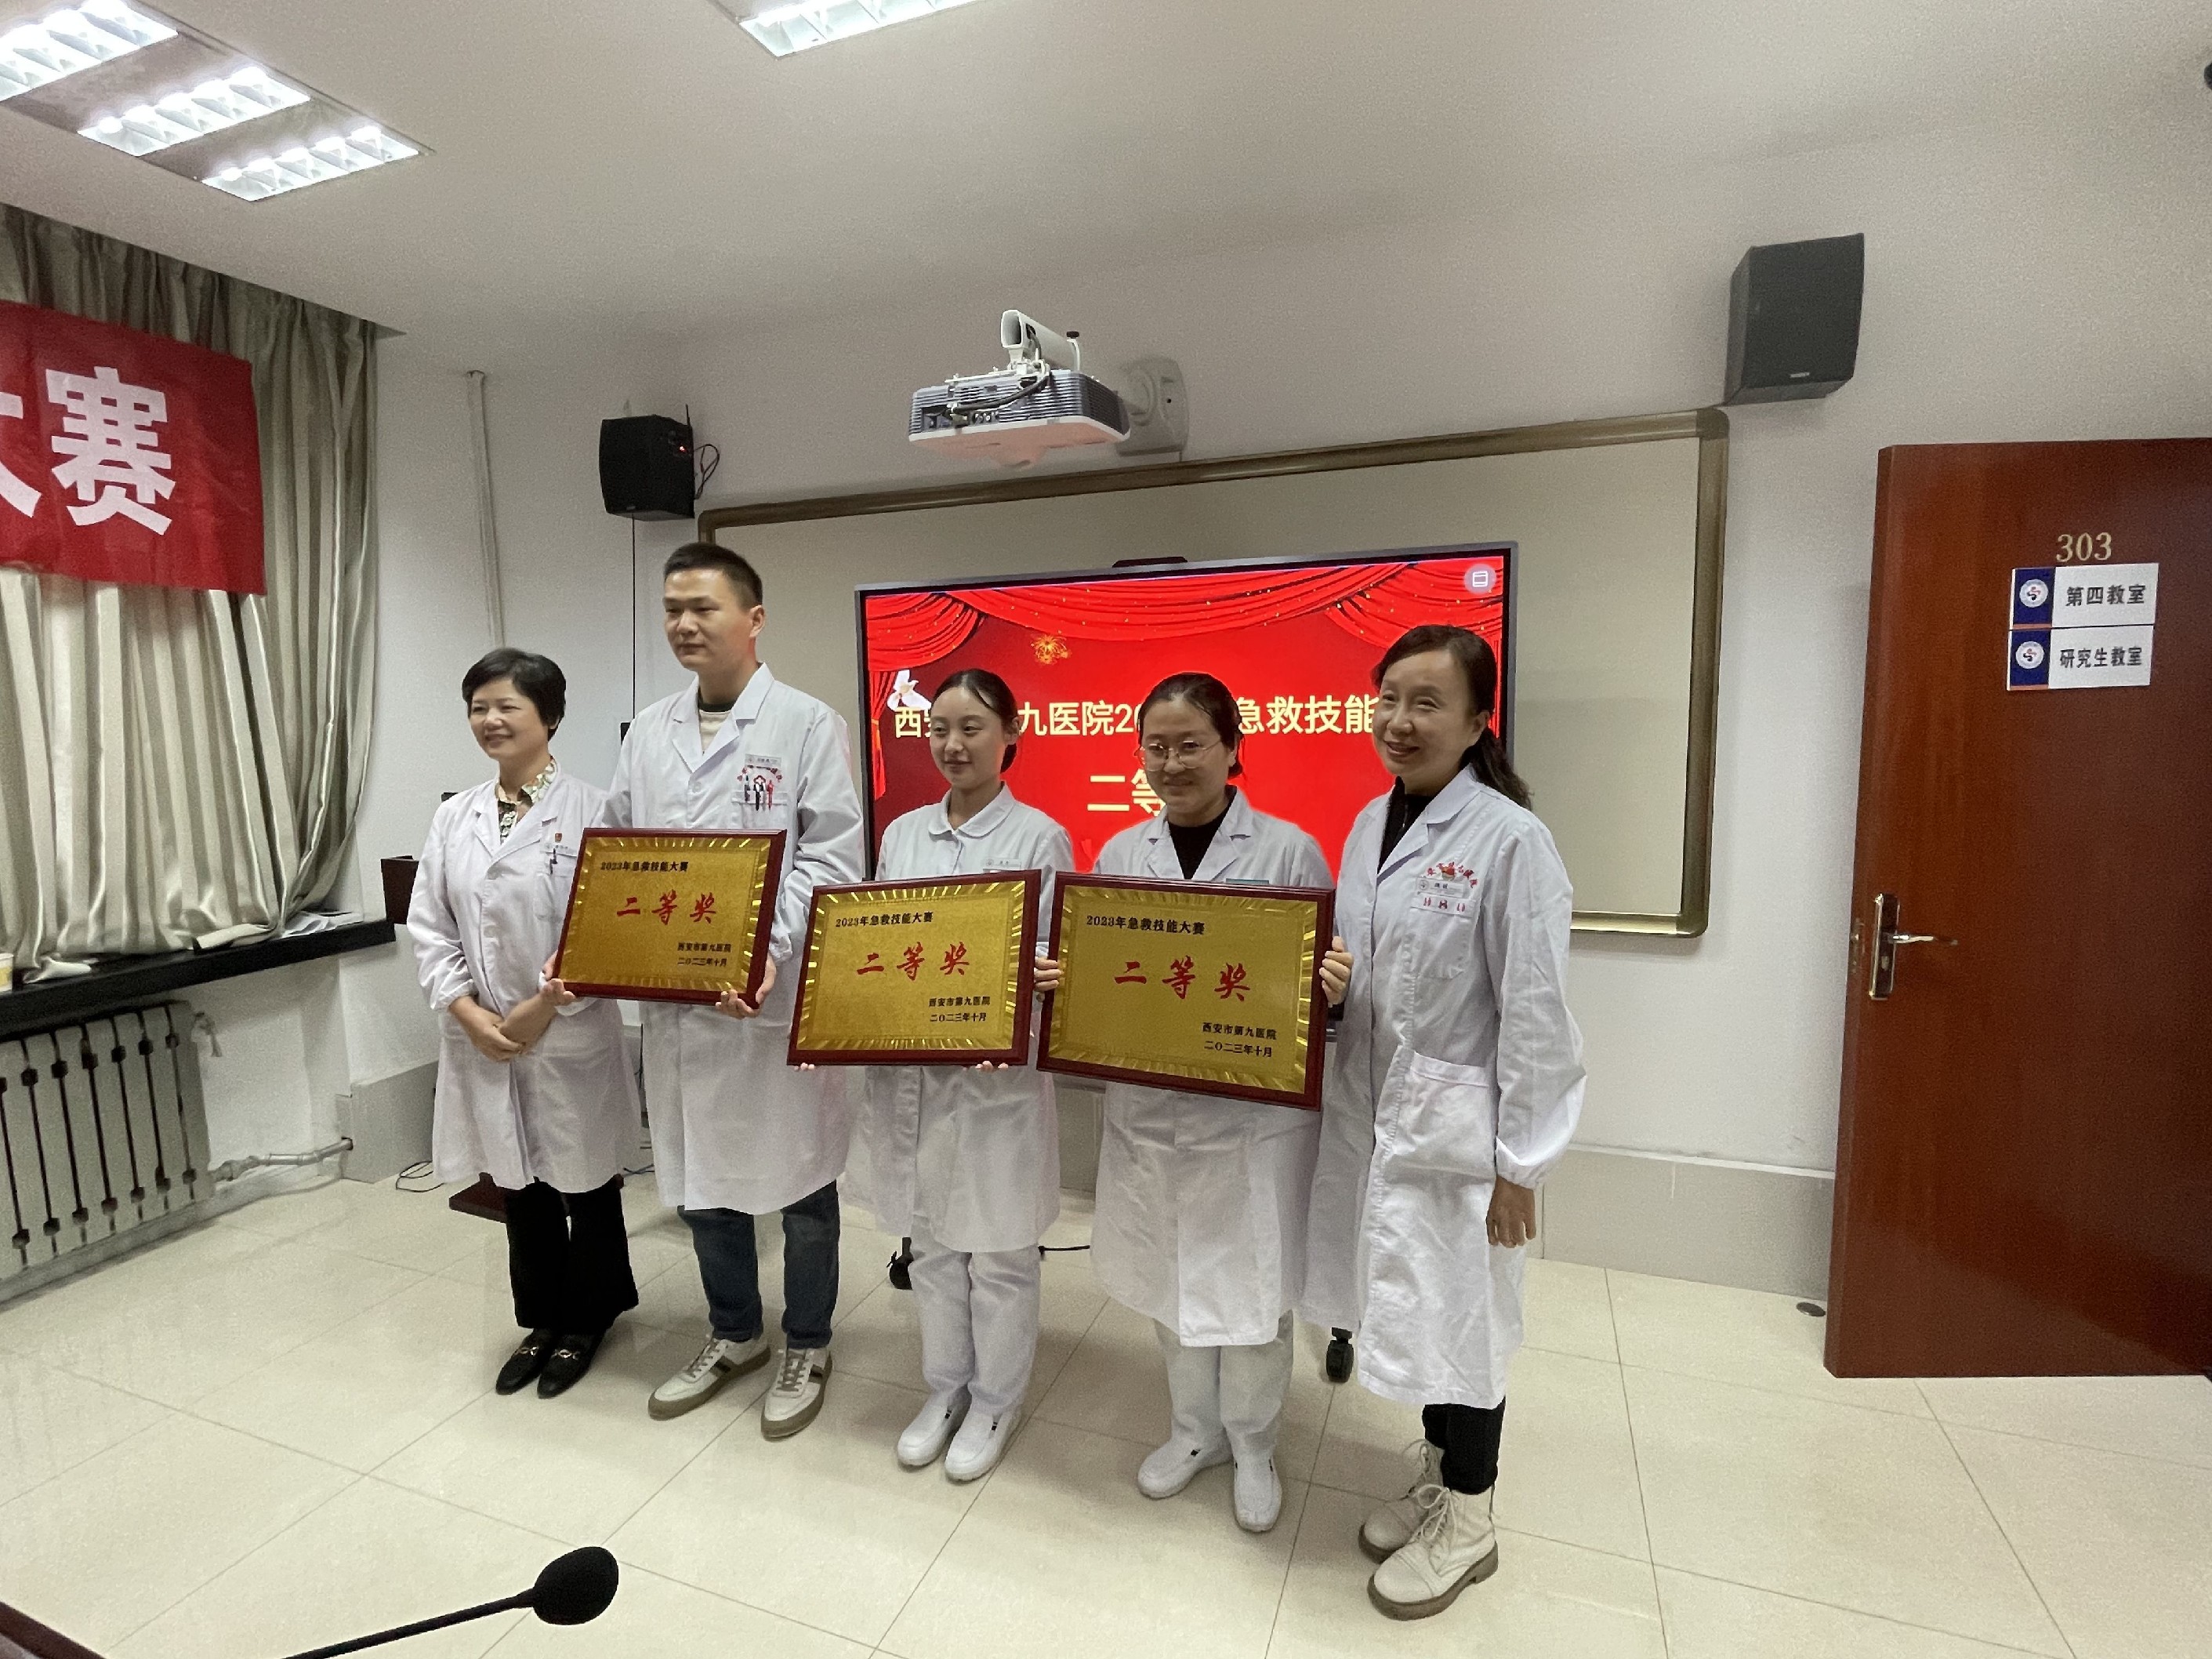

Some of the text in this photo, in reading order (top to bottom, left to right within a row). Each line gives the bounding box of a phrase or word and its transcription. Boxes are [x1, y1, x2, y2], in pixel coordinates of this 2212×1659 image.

[2055, 532, 2112, 562] 303
[2065, 584, 2146, 606] 第四教室
[2059, 646, 2142, 668] 研究生教室
[617, 889, 716, 925] 二等奖
[836, 911, 934, 928] 2023年急救技能大赛
[1086, 916, 1205, 935] 2023年急救技能大赛
[857, 941, 970, 981] 二等奖
[1114, 955, 1251, 1002] 二等奖
[1202, 1022, 1276, 1040] 西安市第九医院
